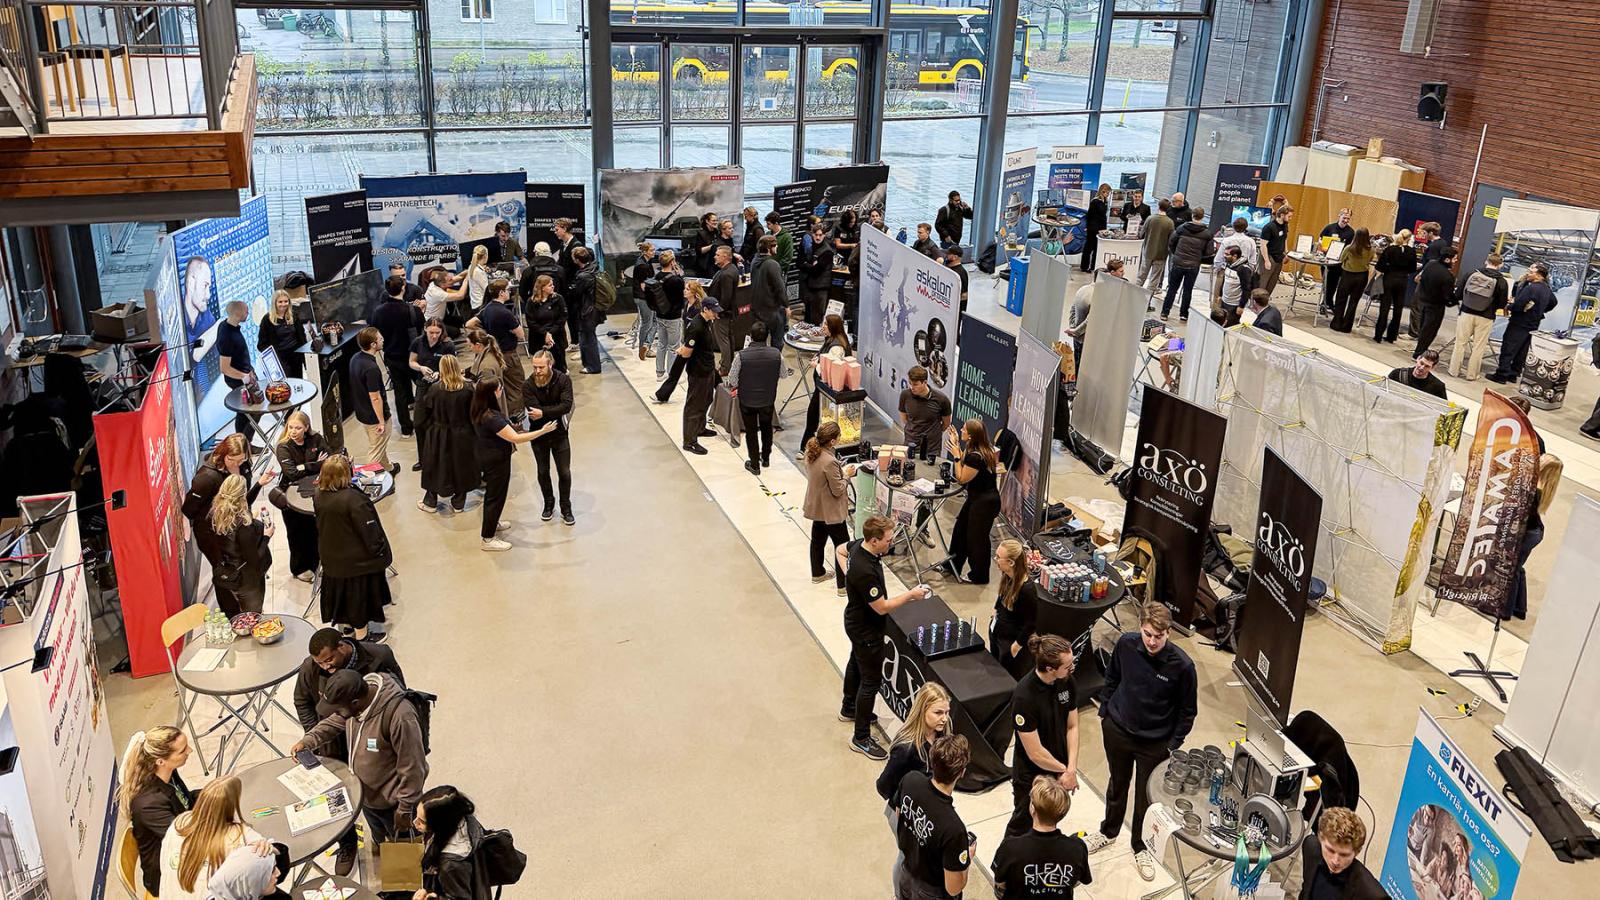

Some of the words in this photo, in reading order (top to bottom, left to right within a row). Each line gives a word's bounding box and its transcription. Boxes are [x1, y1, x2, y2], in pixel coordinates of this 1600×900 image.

[384, 199, 438, 208] PARTNERTECH
[785, 187, 812, 195] EURENCO
[829, 202, 884, 214] EURENCO
[917, 268, 951, 298] askalon
[961, 361, 986, 389] HOME
[985, 384, 991, 393] of
[992, 388, 1000, 398] the
[958, 381, 1000, 420] LEARNING
[1137, 467, 1204, 506] CONSULTING
[1140, 443, 1207, 494] axö
[1259, 511, 1305, 577] axö
[1256, 538, 1301, 592] CONSULTING
[1451, 756, 1502, 821] FLEXIT
[1426, 764, 1437, 781] En
[1437, 775, 1463, 813] karriär
[1463, 810, 1479, 835] hos
[1480, 832, 1500, 857] oss?
[1024, 863, 1073, 877] CLEAR
[1025, 873, 1070, 886] RIVER
